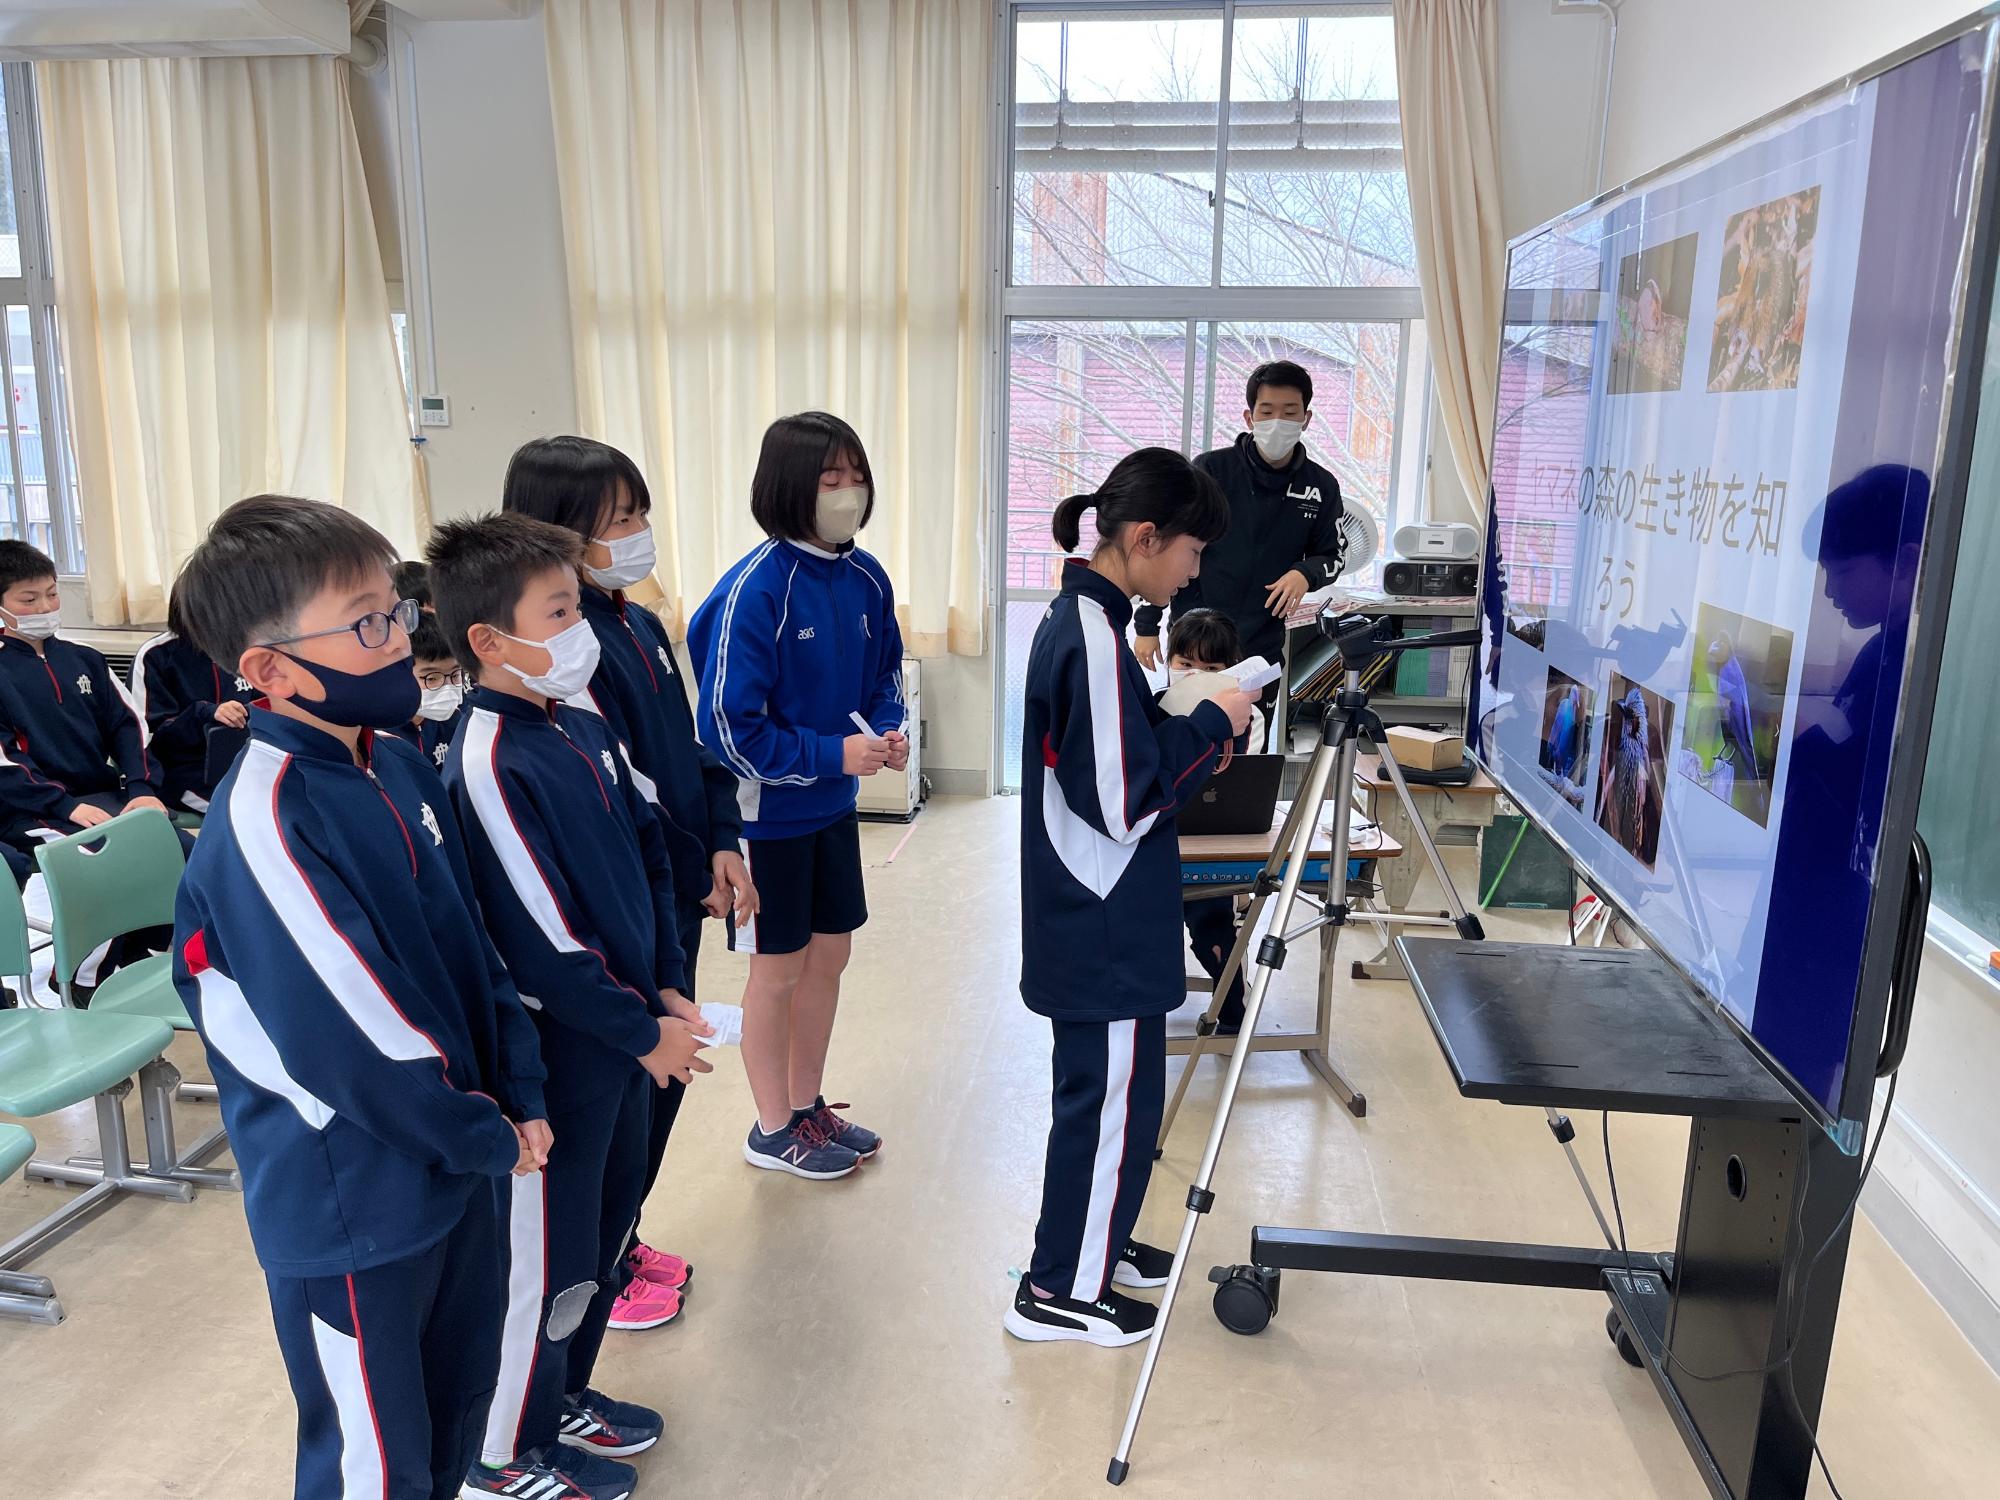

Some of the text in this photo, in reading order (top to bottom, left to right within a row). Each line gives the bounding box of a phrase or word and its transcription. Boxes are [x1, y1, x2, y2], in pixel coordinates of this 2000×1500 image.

[1531, 457, 1788, 557] ヤマネの森の生き物を知
[1597, 555, 1636, 619] ろう
[781, 1144, 811, 1166] N
